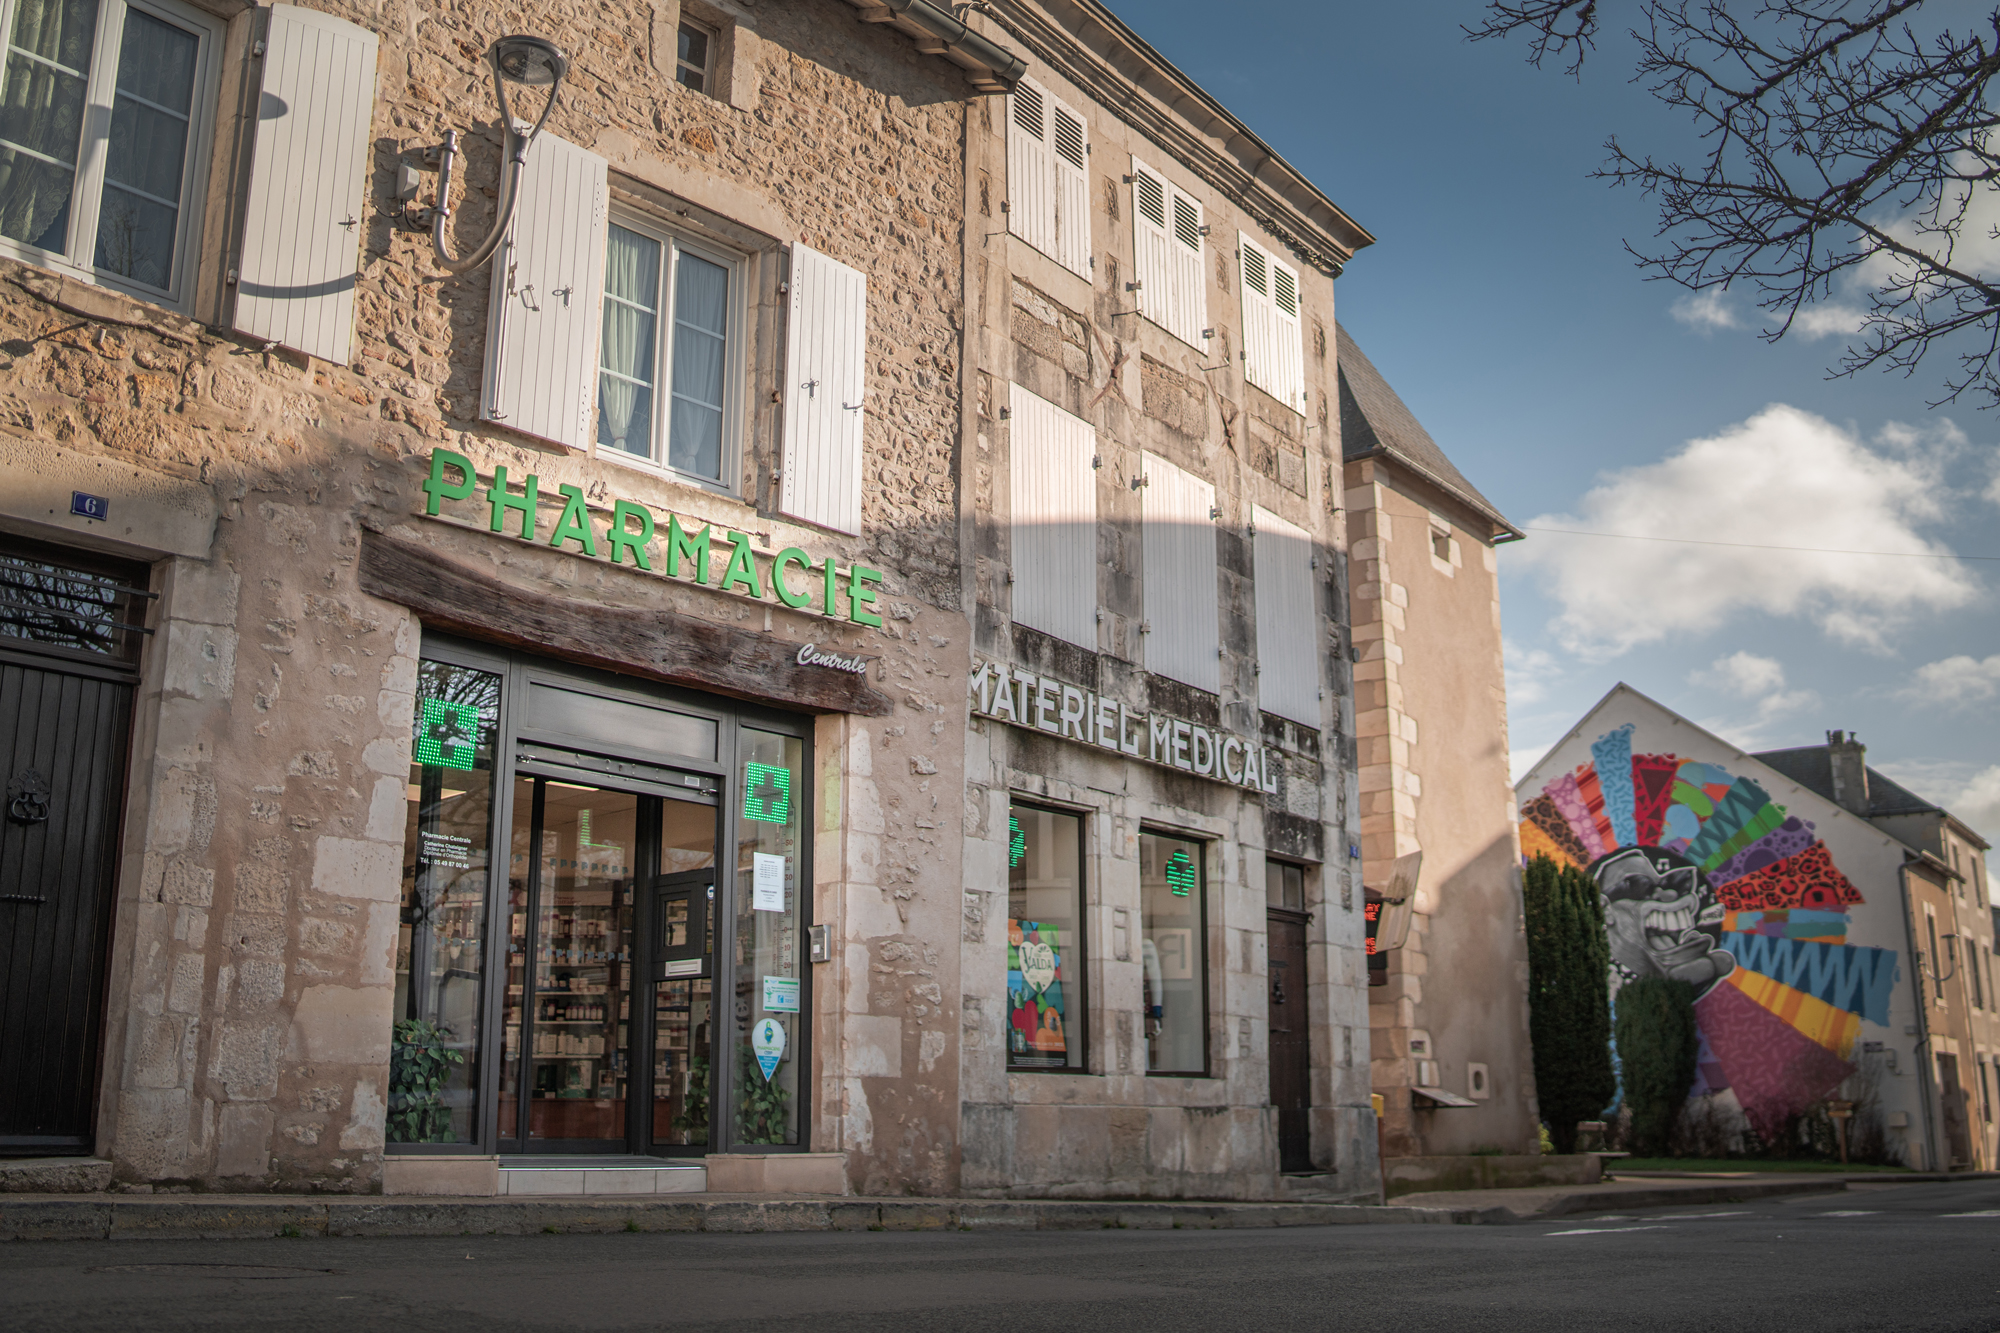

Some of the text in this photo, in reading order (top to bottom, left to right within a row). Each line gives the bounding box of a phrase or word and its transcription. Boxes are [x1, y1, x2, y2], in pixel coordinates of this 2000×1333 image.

[85, 497, 97, 514] 6
[422, 447, 883, 628] PHARMACIE
[797, 643, 866, 674] Centrale
[970, 661, 1277, 794] MATERIEL MEDICAL
[422, 831, 449, 840] Pharmacie
[1021, 946, 1054, 974] VALDA
